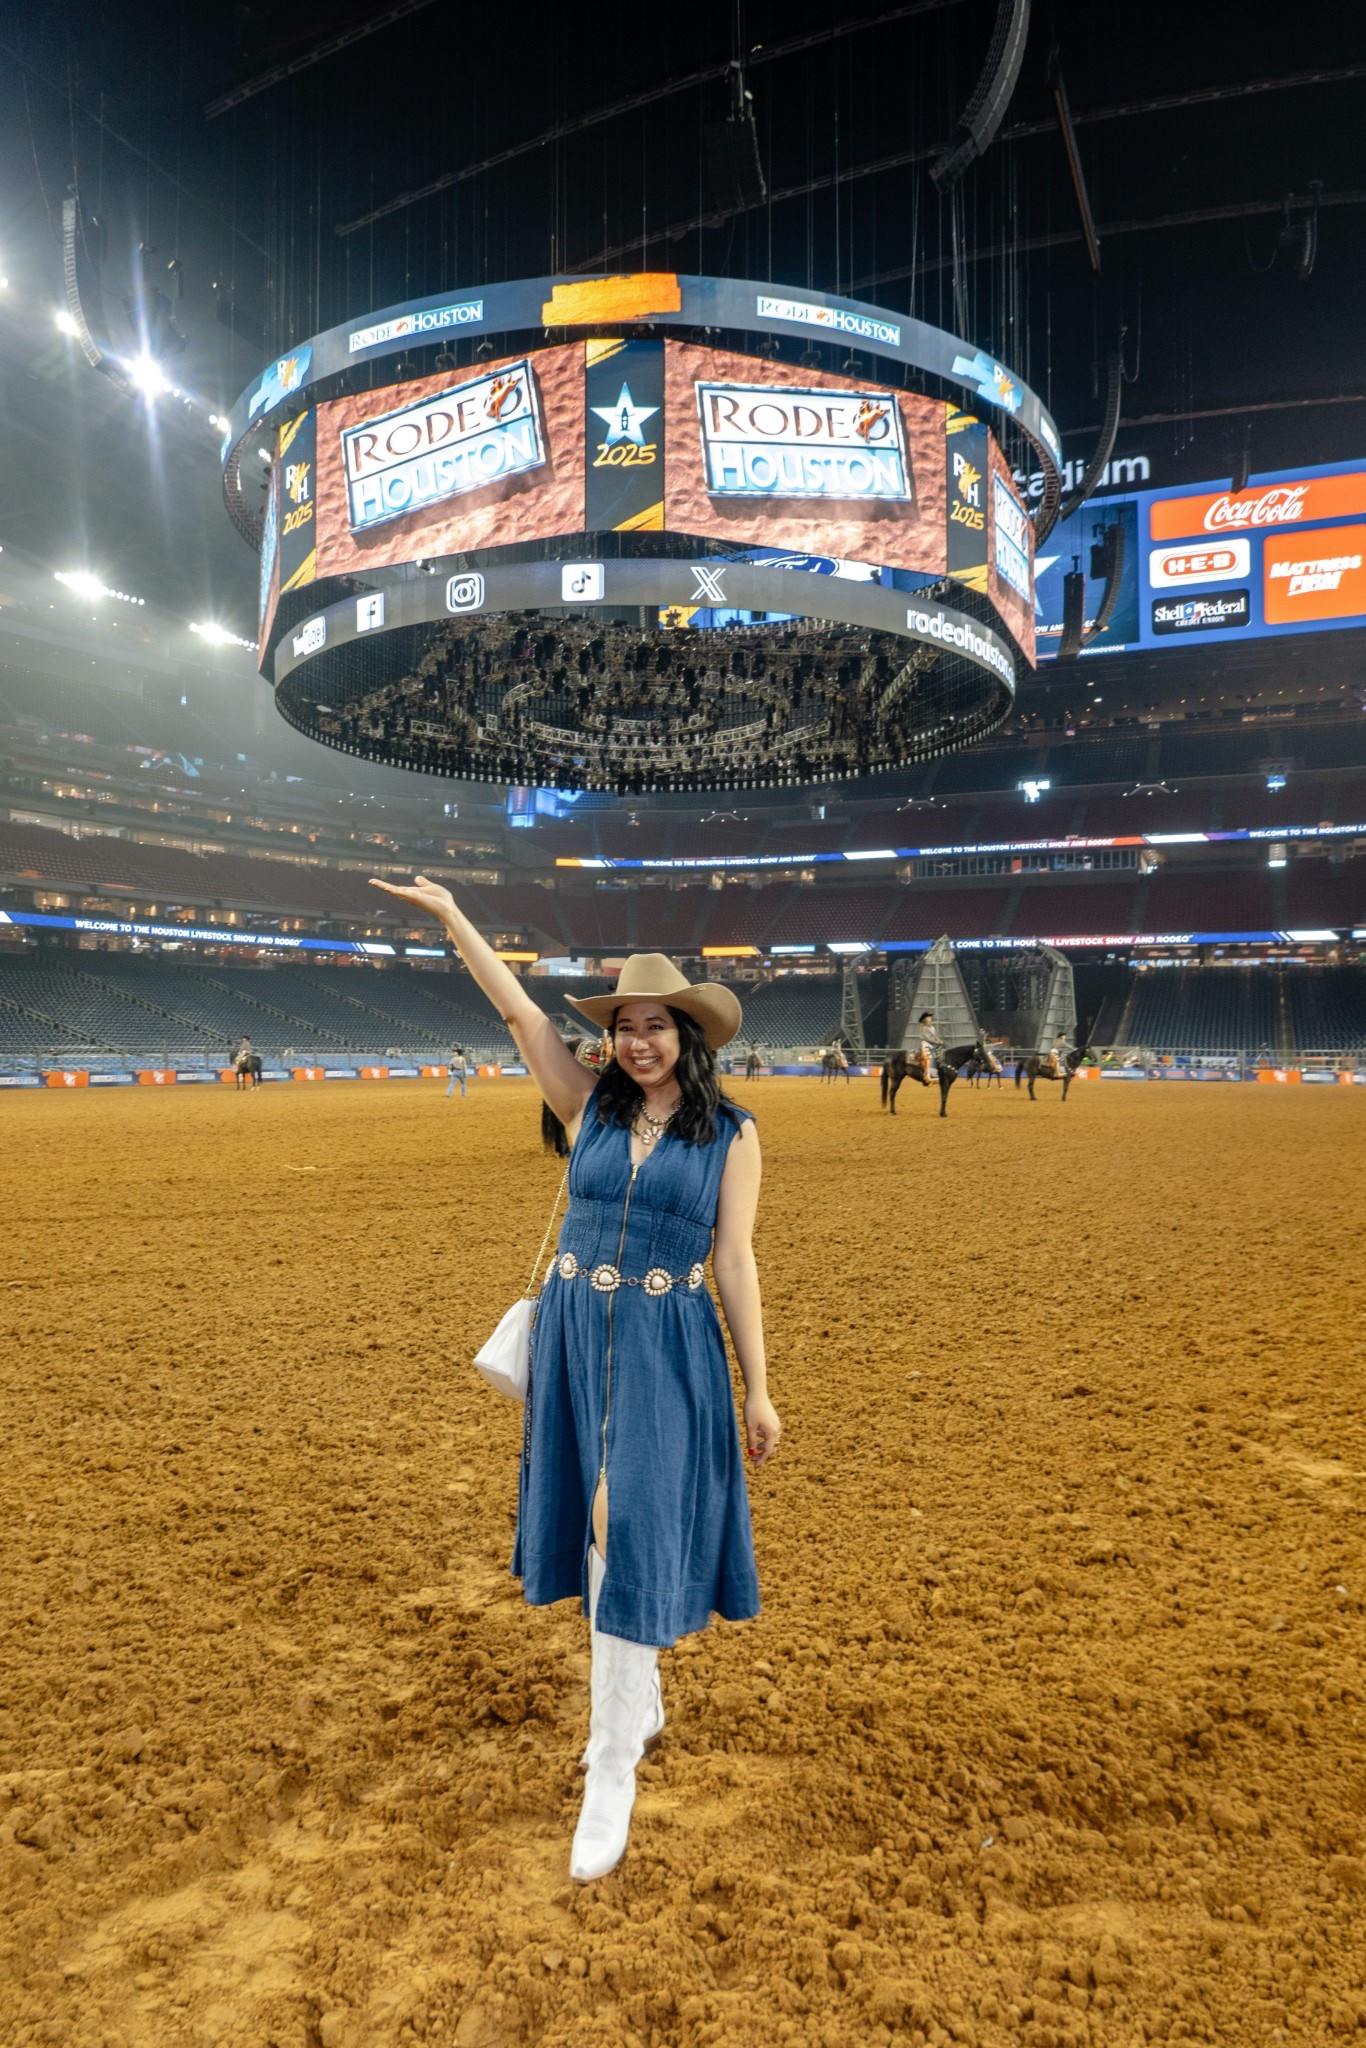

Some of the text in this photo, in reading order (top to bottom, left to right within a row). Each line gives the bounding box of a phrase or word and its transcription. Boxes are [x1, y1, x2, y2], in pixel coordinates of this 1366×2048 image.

[412, 305, 481, 331] HOUSTON
[834, 311, 898, 344] HOUSTON
[353, 384, 524, 473] RODEO
[710, 395, 891, 442] RODEO
[592, 443, 657, 467] 2025
[355, 424, 534, 522] HOUSTON
[712, 445, 900, 492] HOUSTON
[283, 500, 314, 535] 2025
[951, 500, 985, 531] 2025
[1204, 486, 1310, 530] Coca-Cola
[1168, 553, 1231, 574] H-E-B
[1270, 555, 1362, 578] MATTRESS
[1288, 571, 1344, 593] FIRM
[1155, 597, 1245, 622] Shell Federal
[1319, 825, 1357, 833] HOUSTON
[920, 847, 952, 855] WELCOME
[1010, 842, 1047, 850] LIVESTOCK
[1049, 840, 1070, 848] SHOW
[75, 920, 300, 946] WELCOME TO THE HOUSTON LIVESTOCK SHOW AND RODEO
[1056, 937, 1103, 946] LIVESTOCK
[1105, 936, 1133, 944] SHOW
[1134, 935, 1154, 943] AND
[1156, 934, 1189, 943] RODEO
